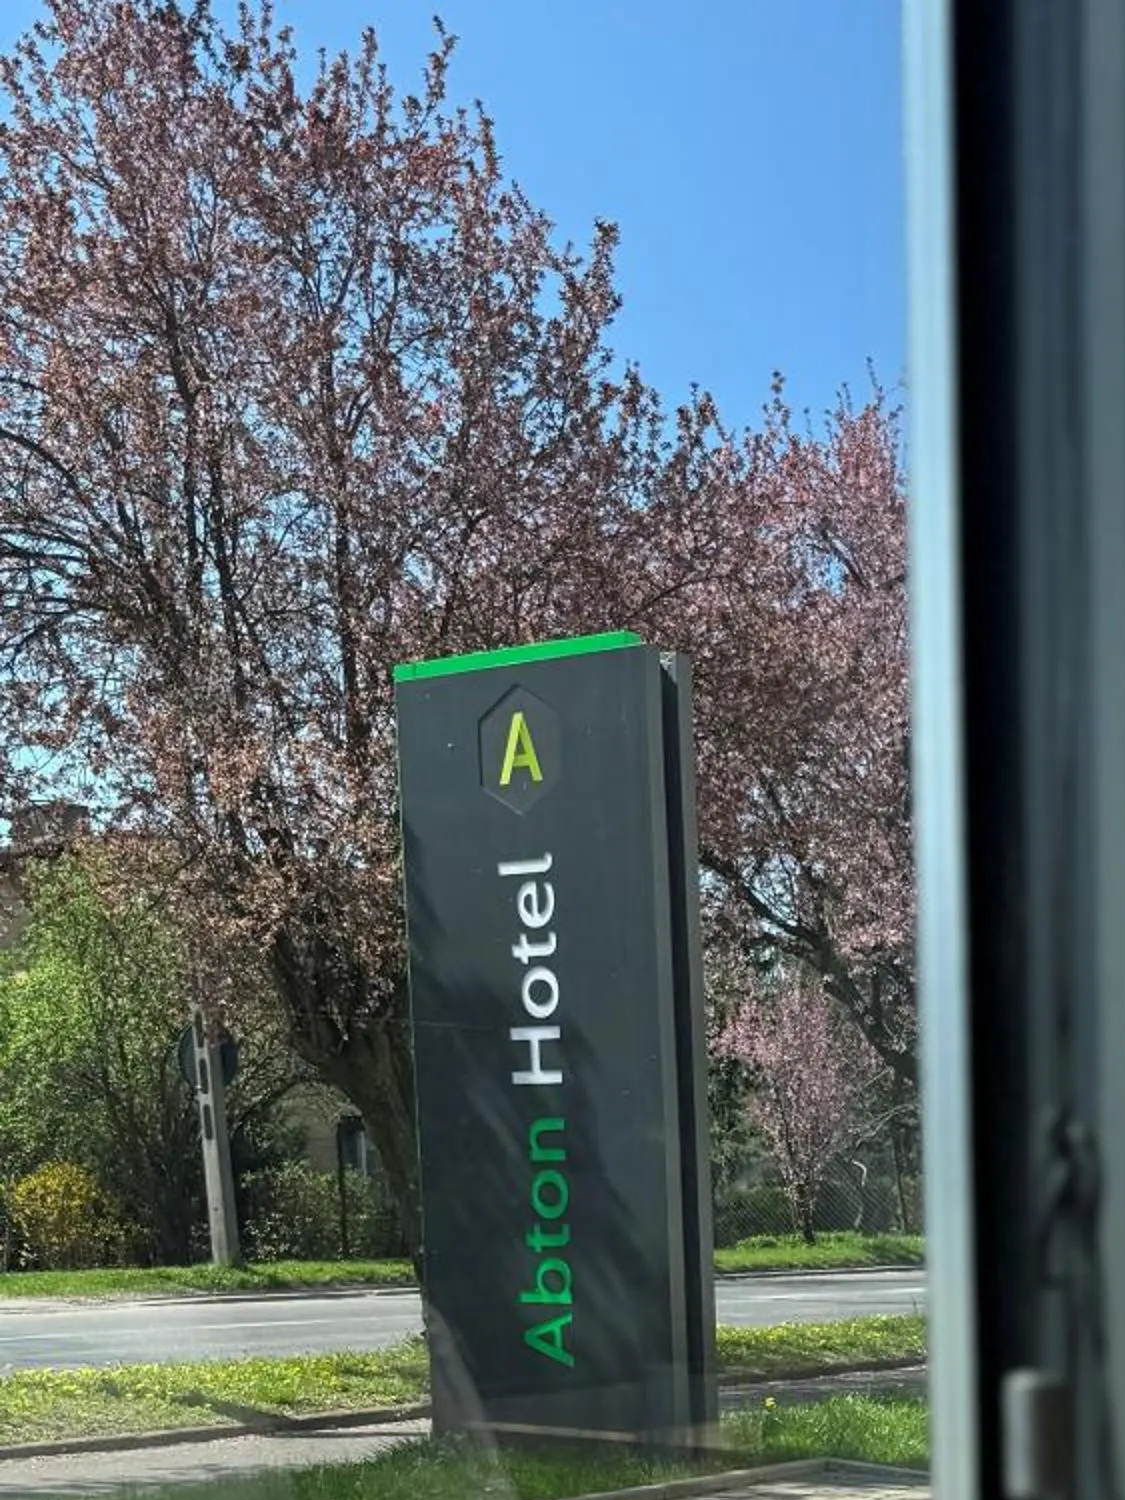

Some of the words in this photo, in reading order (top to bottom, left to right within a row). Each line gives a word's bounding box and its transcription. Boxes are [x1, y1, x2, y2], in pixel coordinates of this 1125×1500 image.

[499, 712, 543, 786] A
[498, 852, 564, 1085] Hotel
[519, 1117, 575, 1367] Abton
